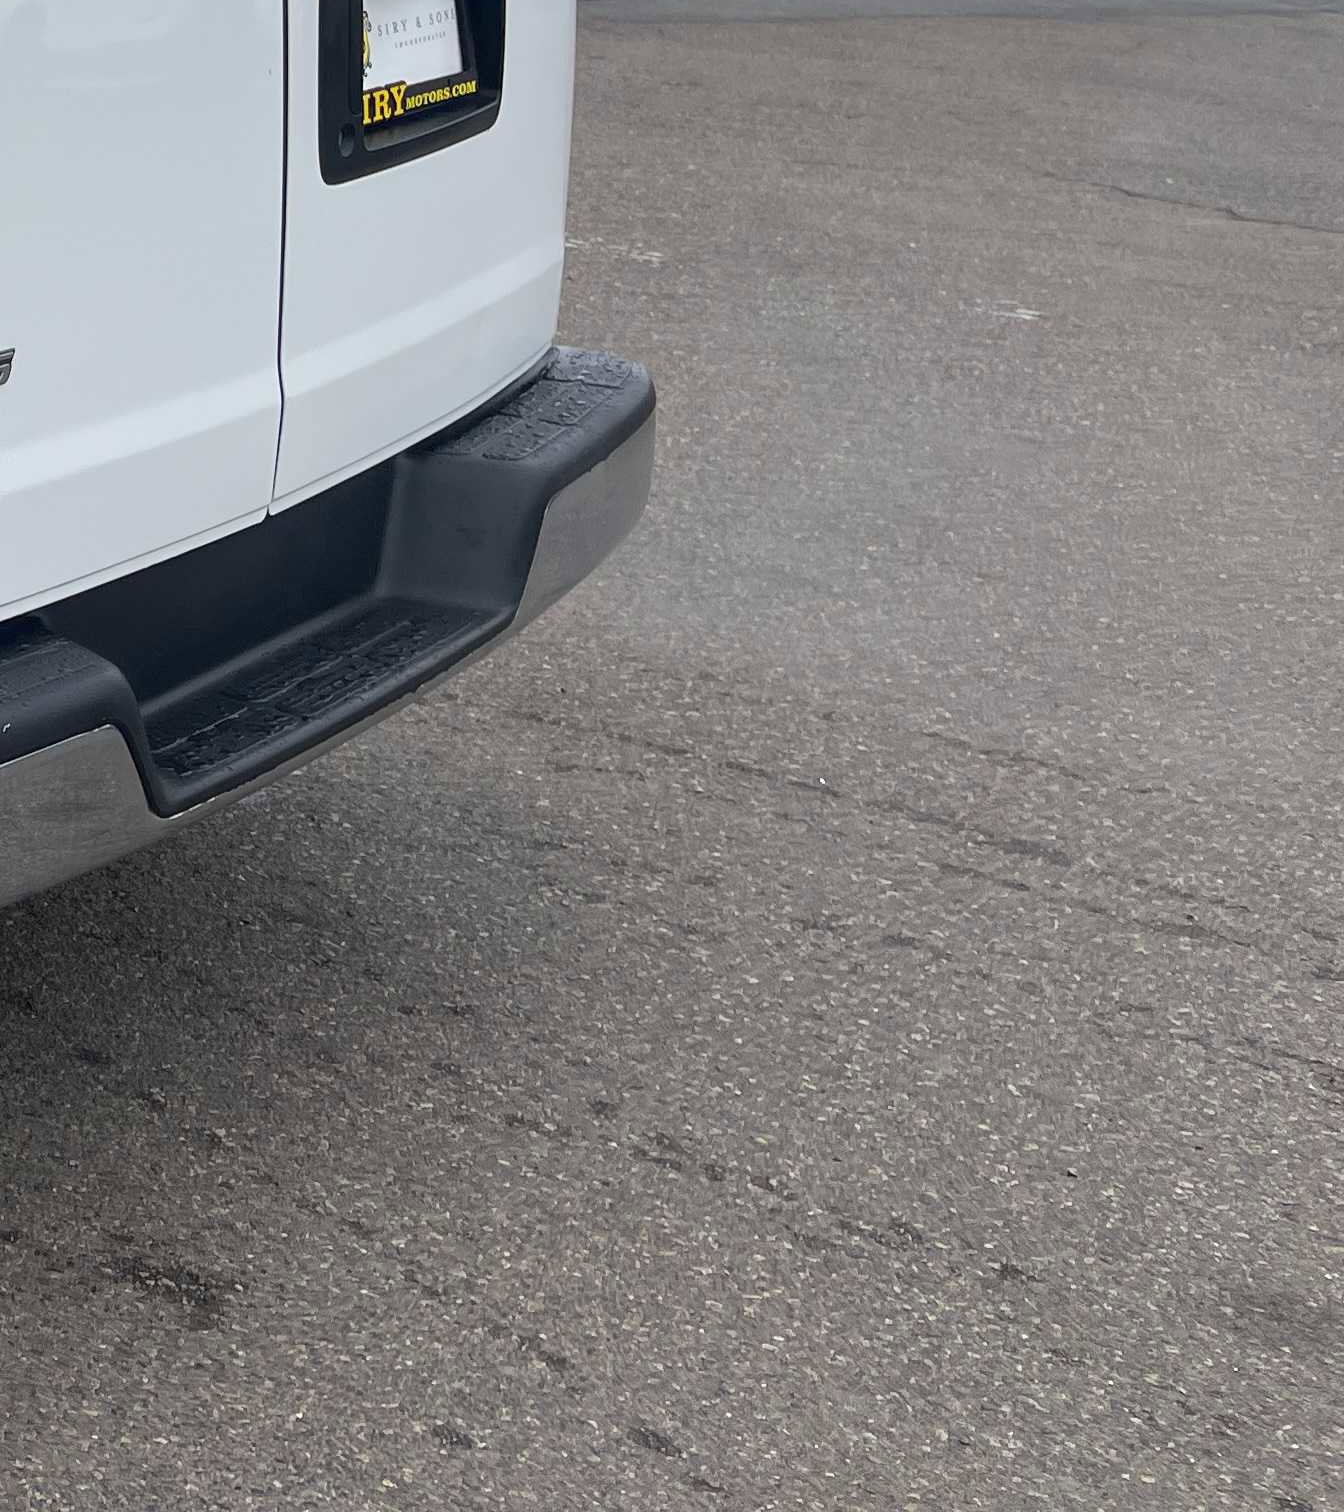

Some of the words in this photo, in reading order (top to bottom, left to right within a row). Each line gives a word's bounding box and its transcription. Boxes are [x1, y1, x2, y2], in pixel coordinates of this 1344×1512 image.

[377, 18, 408, 37] SIRY
[362, 84, 408, 125] IRY
[405, 80, 477, 111] MOTORS.COM
